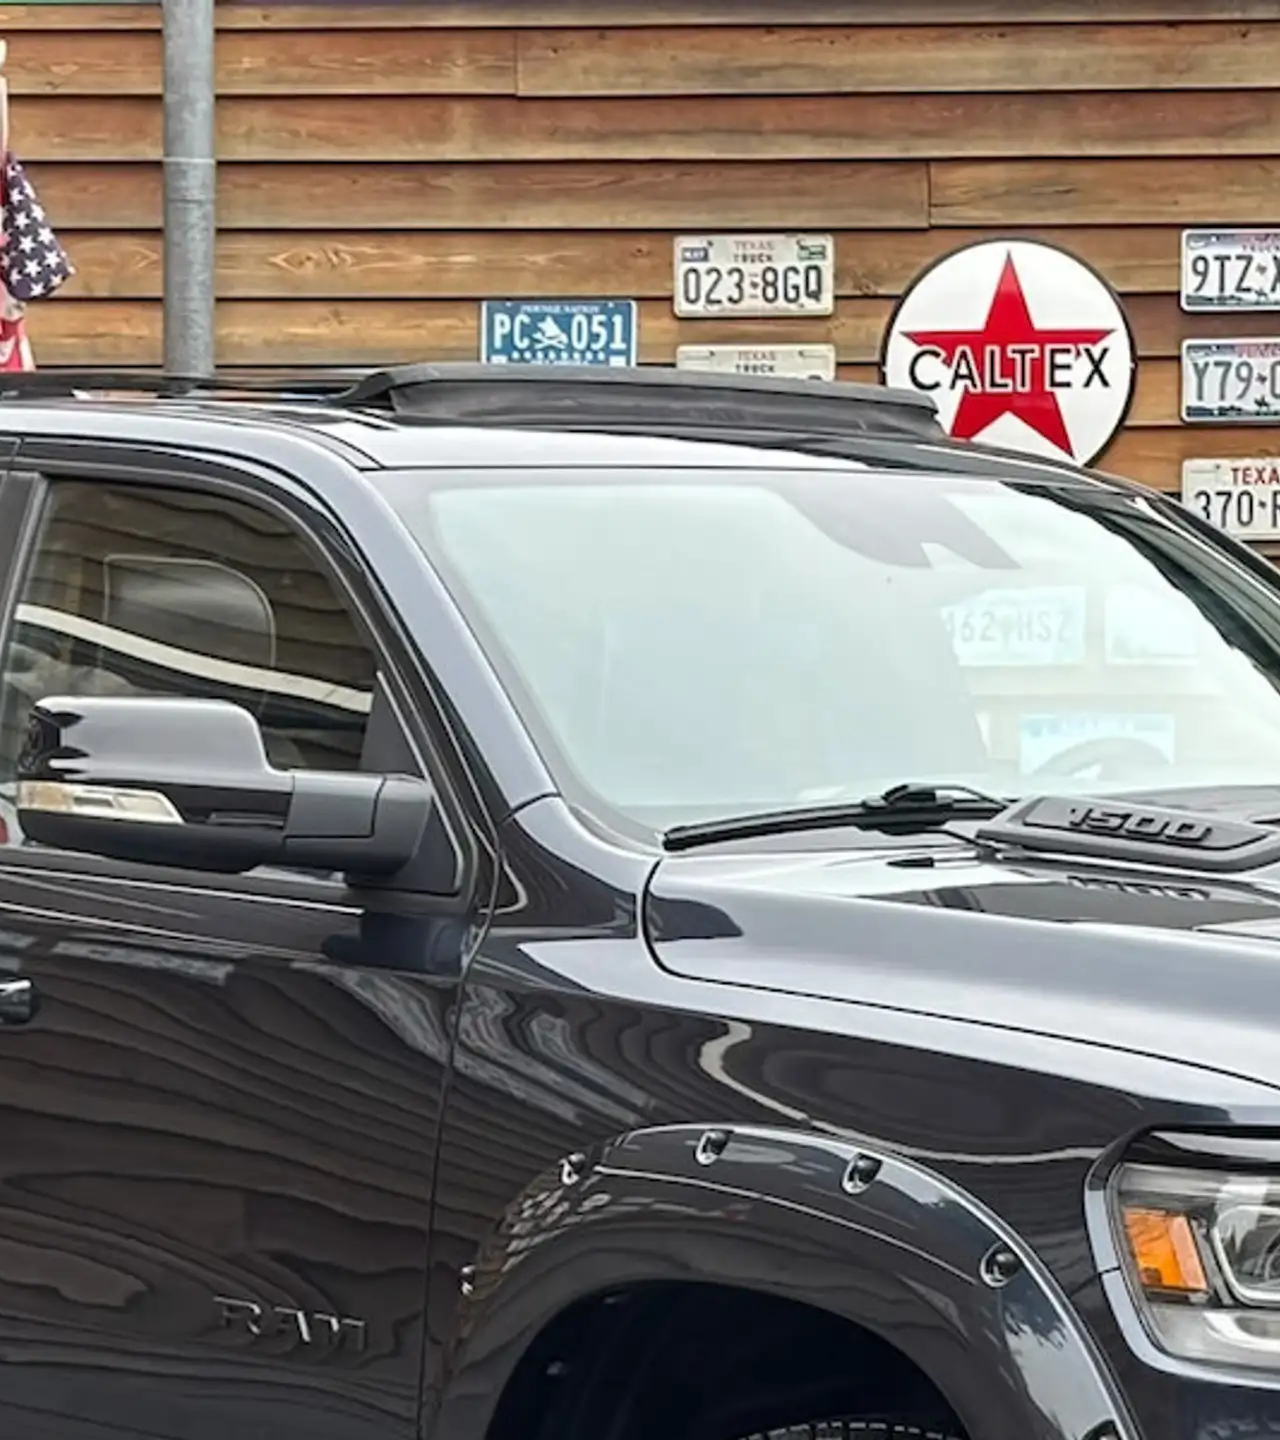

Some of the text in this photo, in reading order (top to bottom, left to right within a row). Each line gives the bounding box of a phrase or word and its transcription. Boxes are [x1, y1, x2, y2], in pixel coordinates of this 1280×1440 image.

[908, 347, 1111, 391] CALTEX
[1069, 805, 1214, 844] 1500
[213, 1296, 366, 1351] RAM
